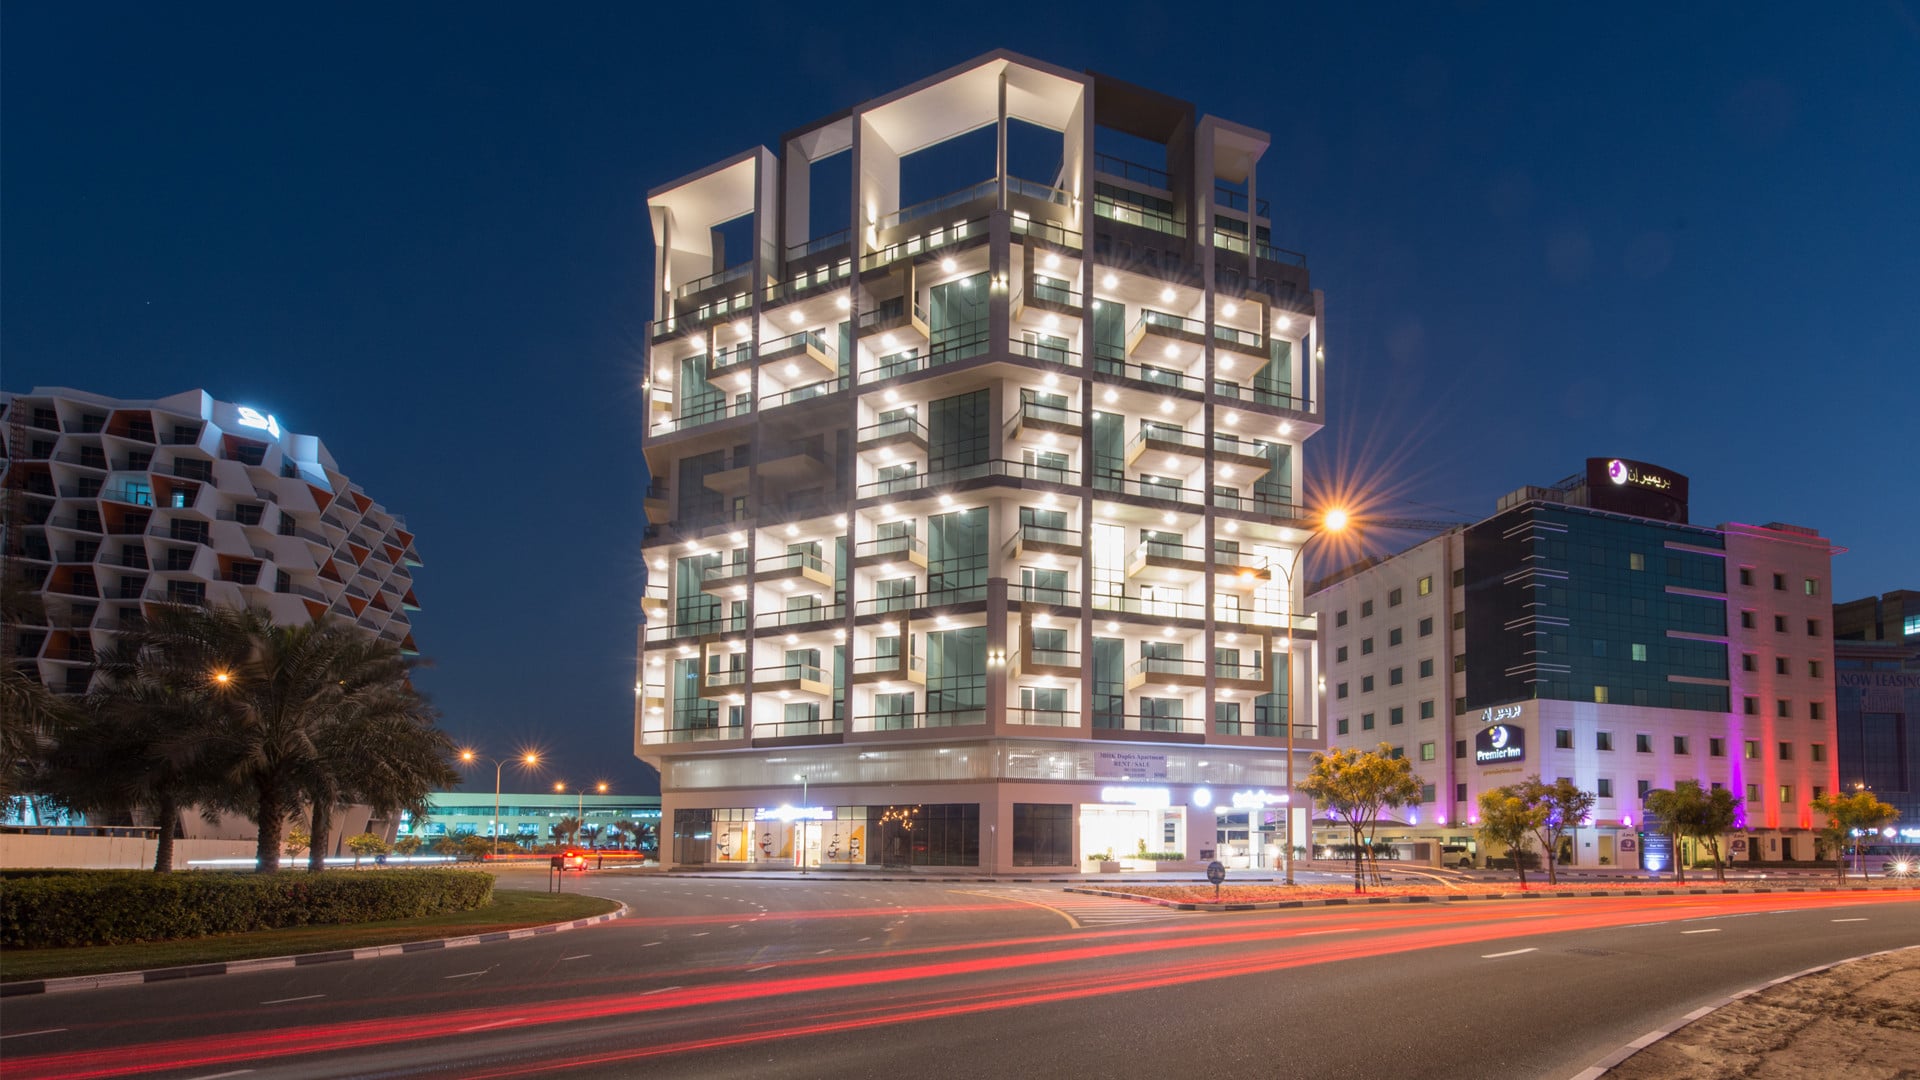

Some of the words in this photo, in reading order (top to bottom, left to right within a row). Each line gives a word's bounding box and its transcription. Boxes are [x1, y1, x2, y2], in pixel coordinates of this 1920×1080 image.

[1841, 674, 1871, 686] NOW
[1477, 749, 1507, 761] Premier
[1507, 747, 1520, 758] Inn
